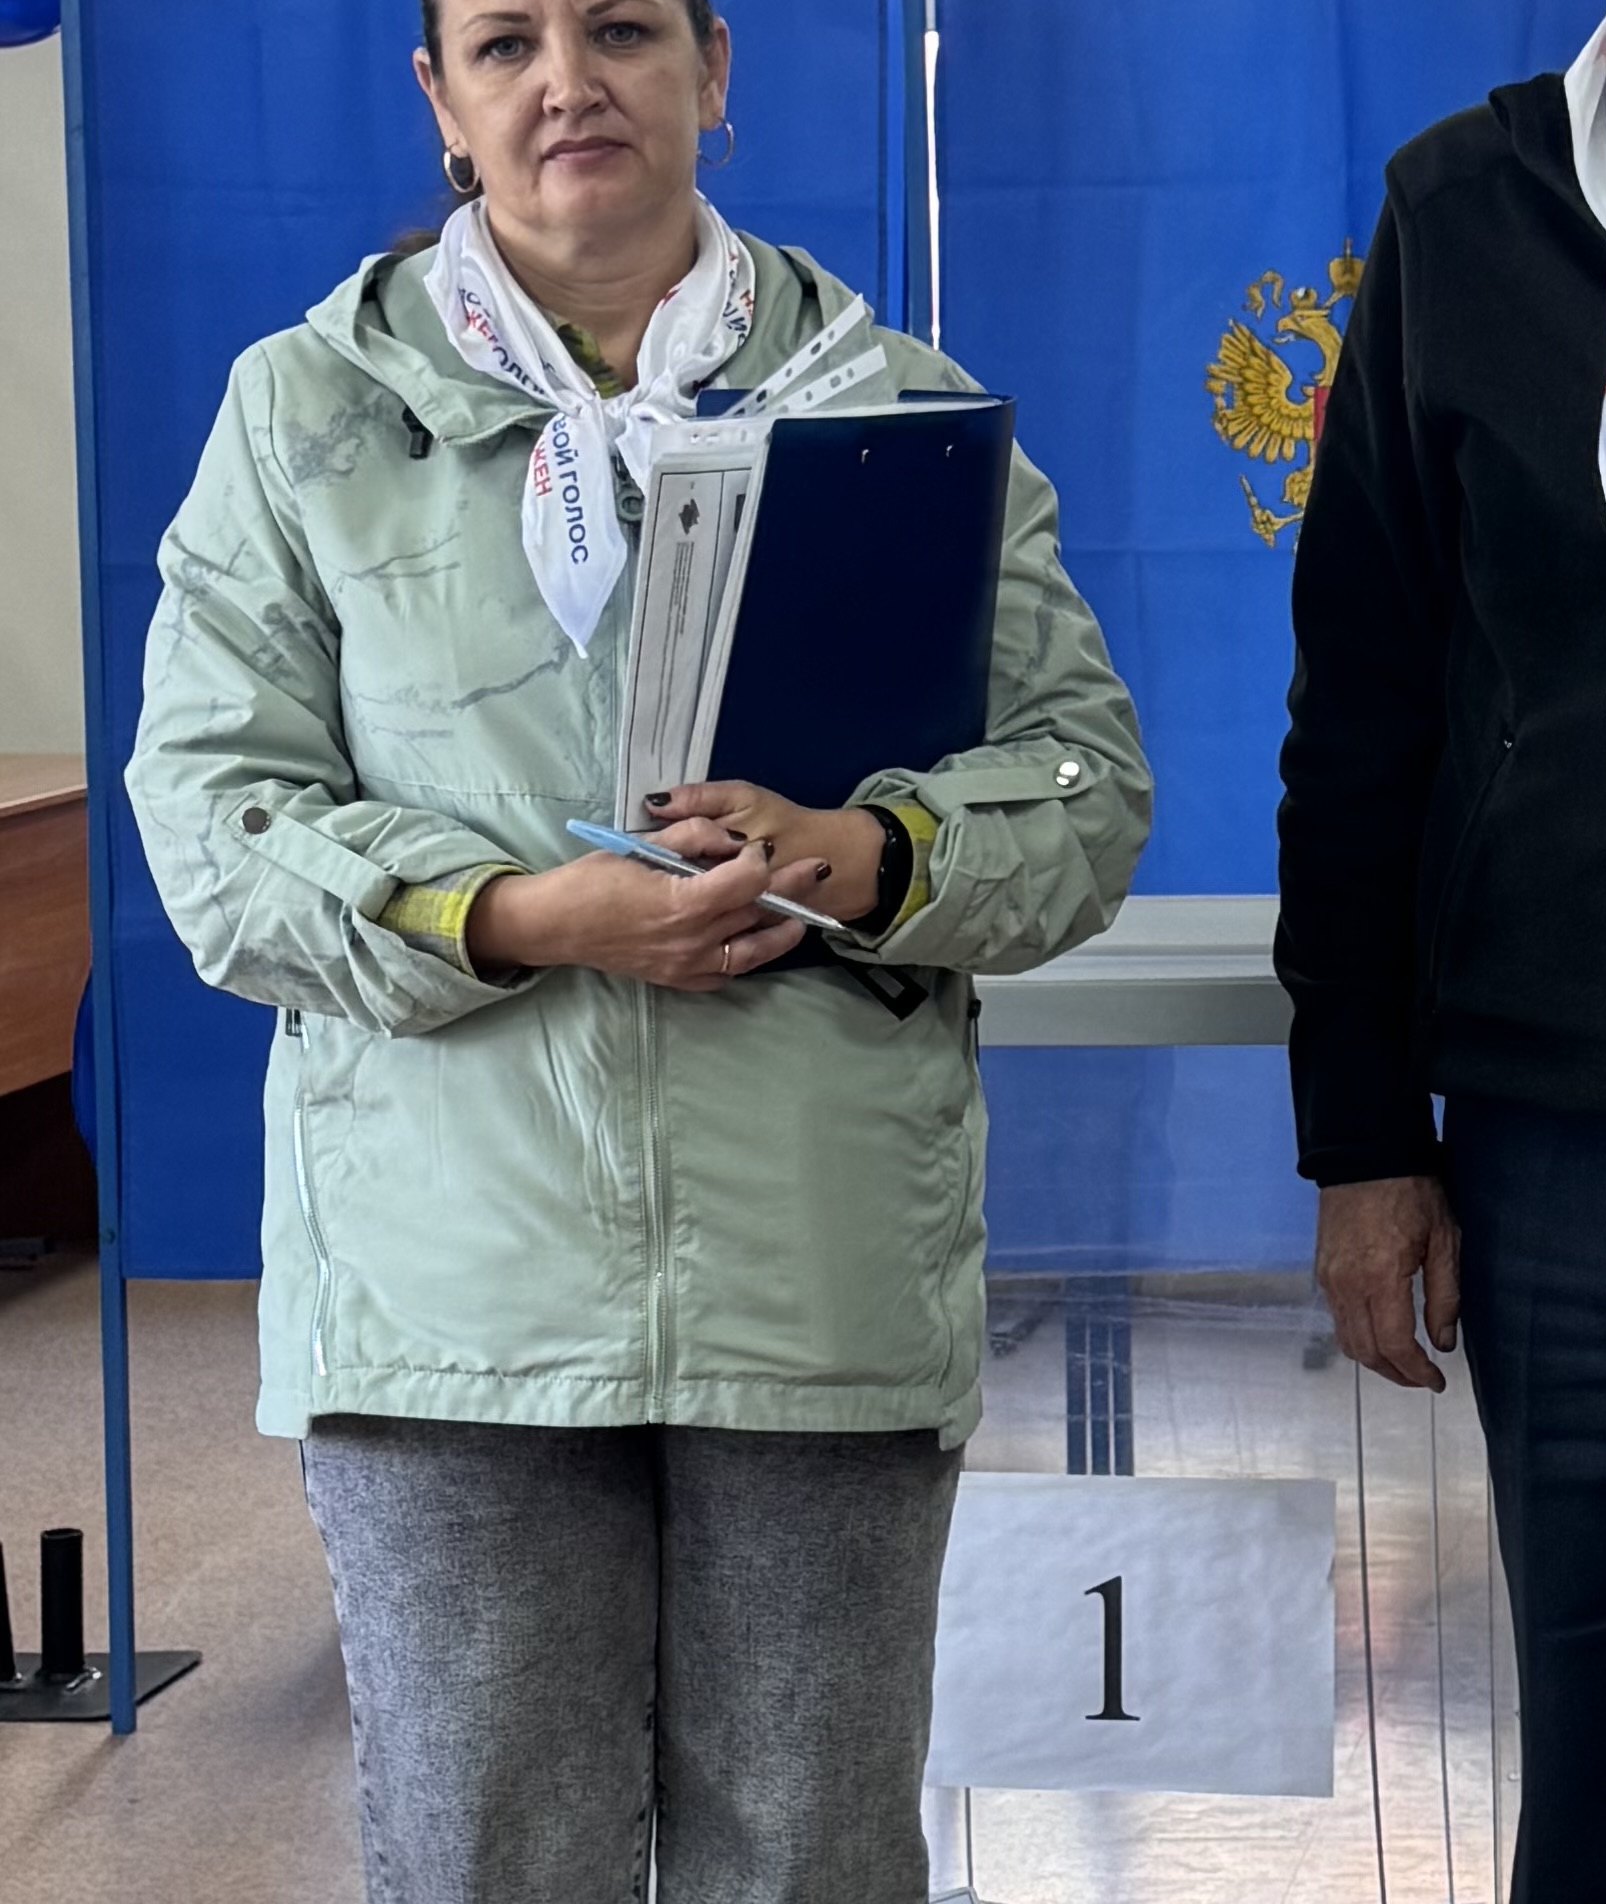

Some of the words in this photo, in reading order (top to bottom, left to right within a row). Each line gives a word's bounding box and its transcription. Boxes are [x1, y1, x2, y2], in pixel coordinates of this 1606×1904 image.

[532, 440, 553, 497] ЖЕН
[552, 417, 579, 467] ВОЙ
[558, 470, 589, 565] ГОЛОС
[1084, 1575, 1140, 1721] 1
